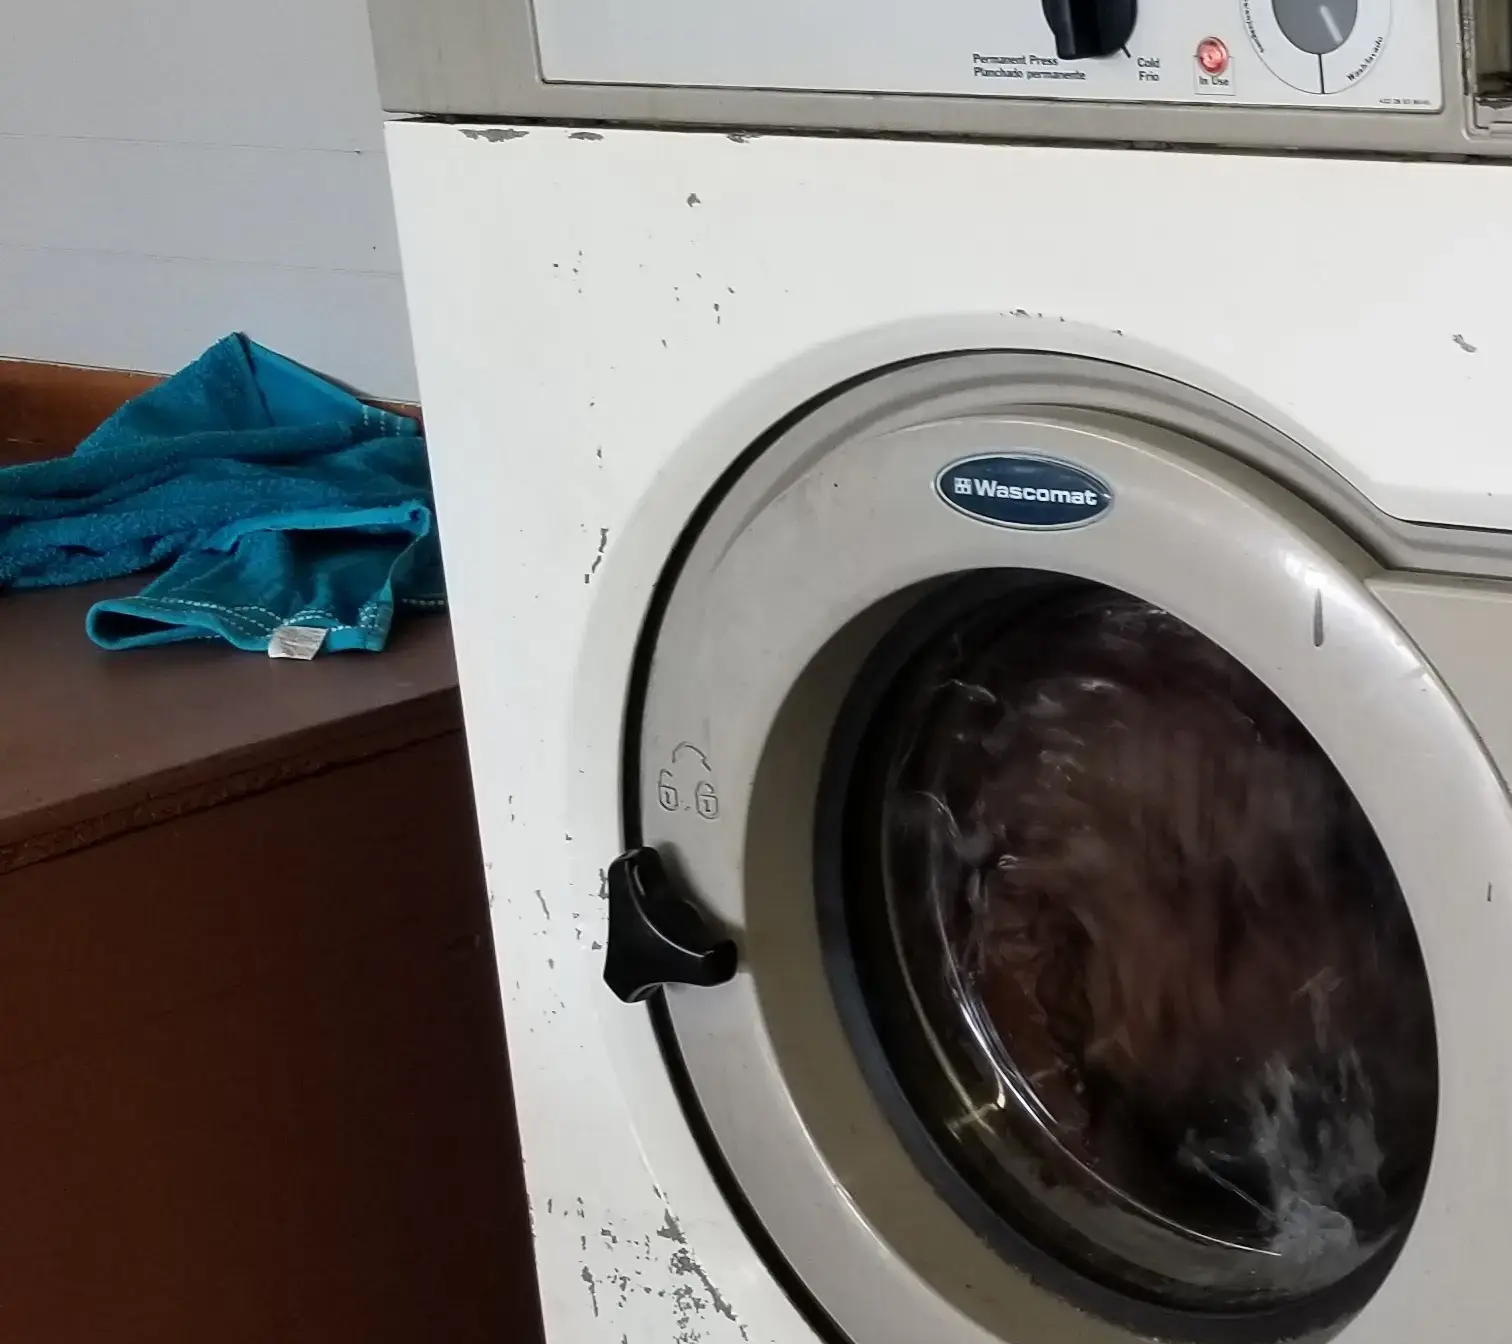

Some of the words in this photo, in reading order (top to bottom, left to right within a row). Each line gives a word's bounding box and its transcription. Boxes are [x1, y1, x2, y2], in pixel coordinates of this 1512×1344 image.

[972, 54, 1027, 66] Permanent
[1029, 55, 1058, 67] Press
[1137, 57, 1160, 68] Cold
[974, 67, 1024, 80] Planchado
[1026, 69, 1086, 81] permanente
[1211, 76, 1230, 86] Use
[973, 478, 1098, 506] Wascomat
